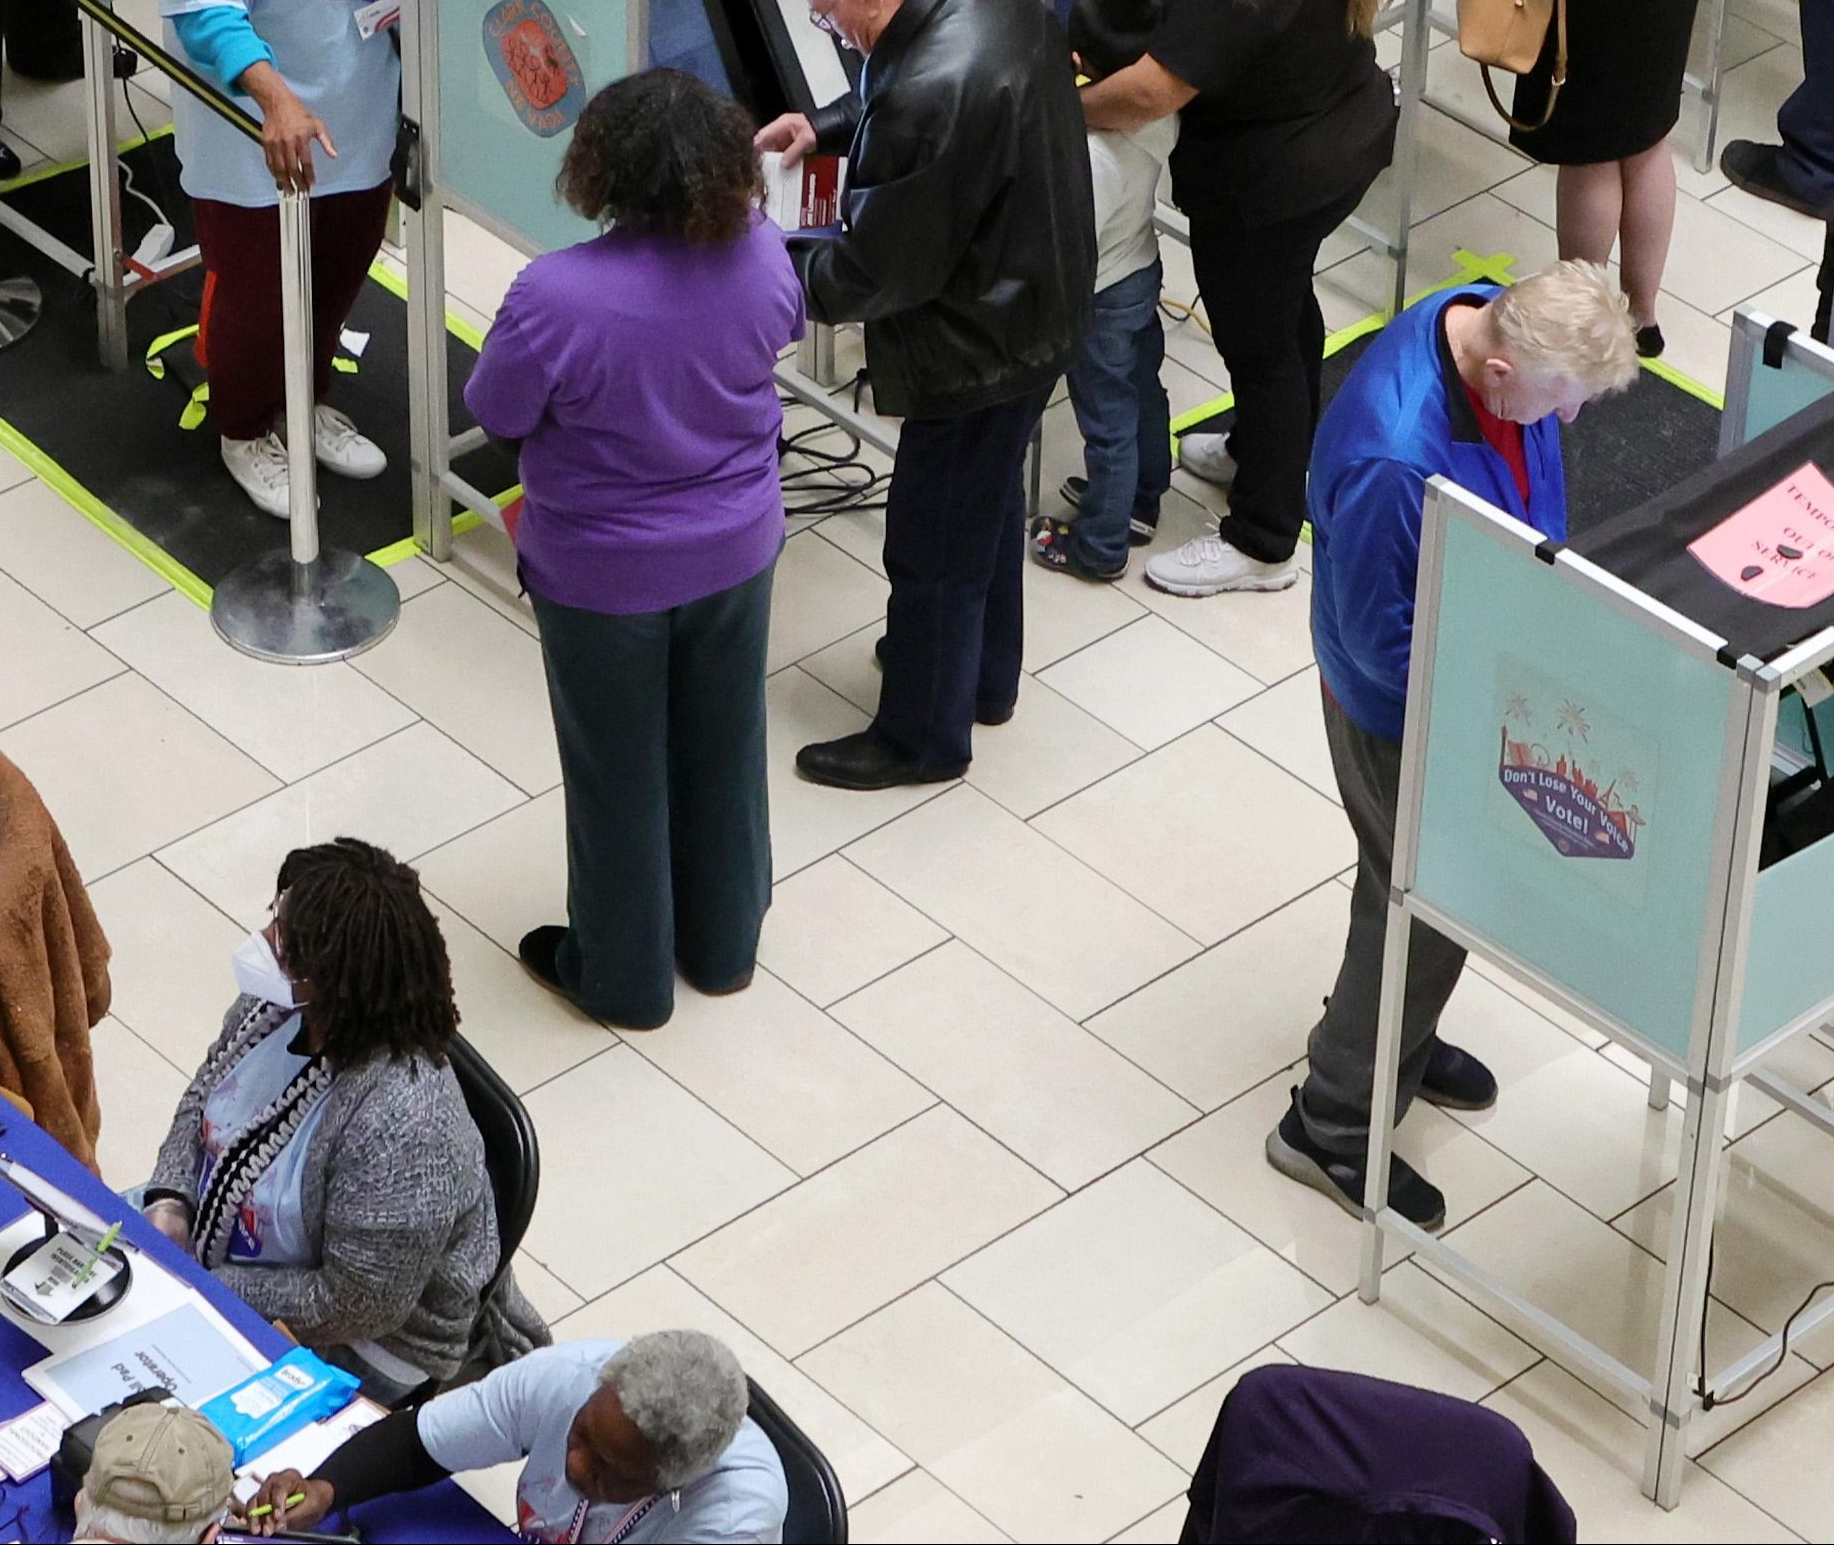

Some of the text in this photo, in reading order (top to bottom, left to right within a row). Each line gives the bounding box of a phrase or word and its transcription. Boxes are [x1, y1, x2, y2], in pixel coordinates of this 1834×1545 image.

[1783, 527, 1816, 550] OUT
[1753, 539, 1817, 580] SERVICE
[1503, 769, 1535, 784] Don't
[1539, 772, 1567, 793] Lose
[1570, 785, 1596, 815] Your
[1600, 810, 1629, 852] Voice
[1546, 795, 1589, 834] Vote!
[111, 1362, 135, 1384] Pad
[134, 1350, 178, 1392] Operator
